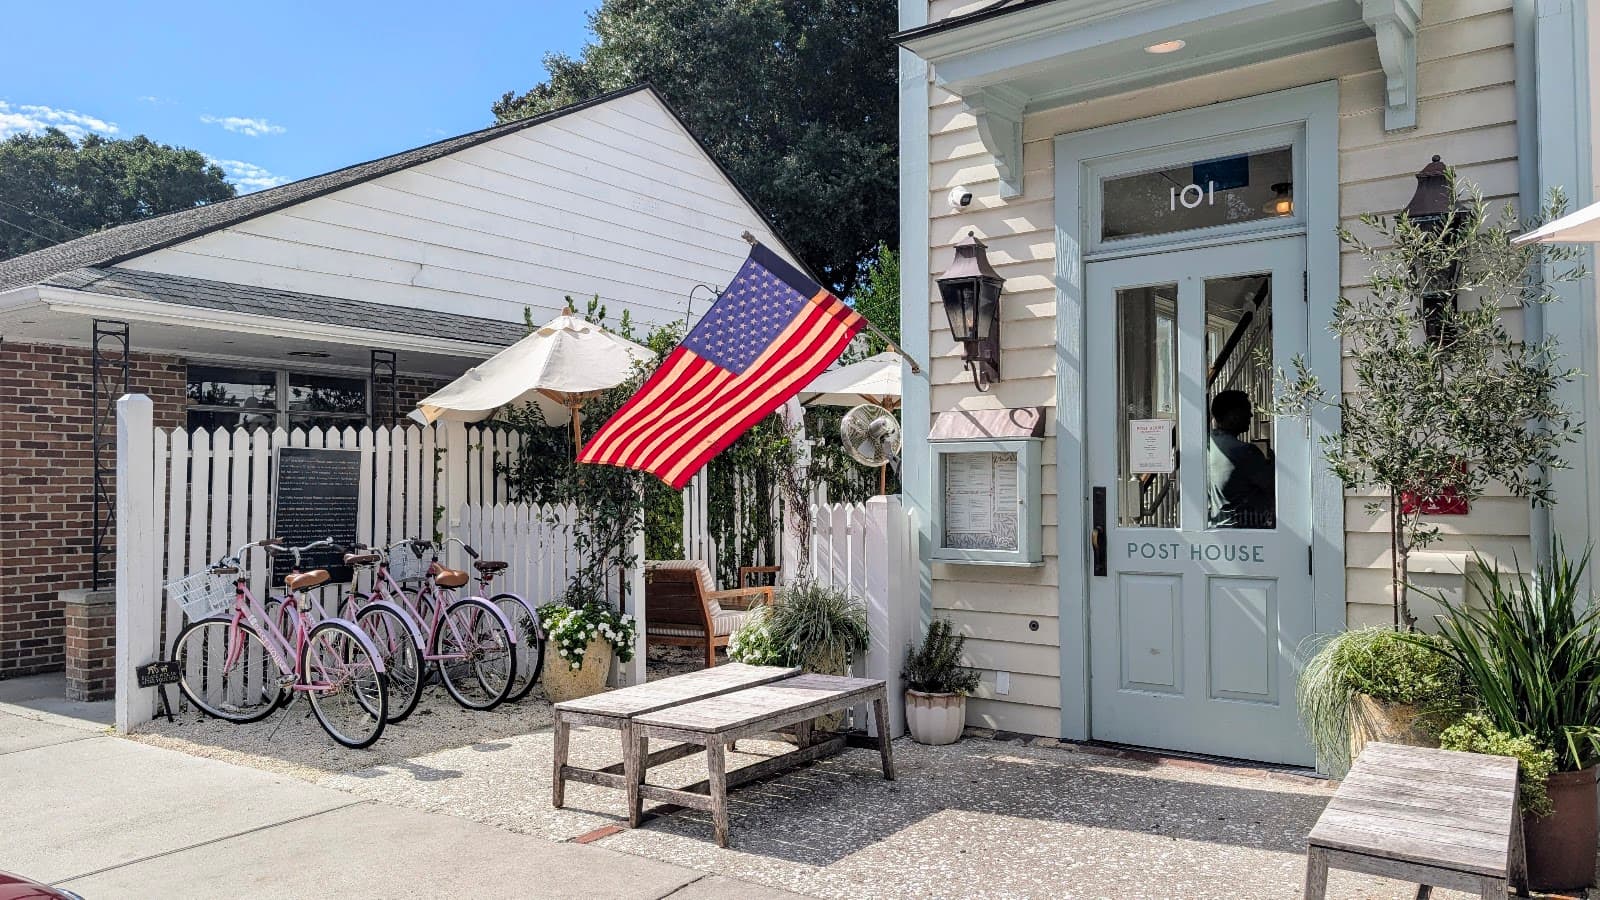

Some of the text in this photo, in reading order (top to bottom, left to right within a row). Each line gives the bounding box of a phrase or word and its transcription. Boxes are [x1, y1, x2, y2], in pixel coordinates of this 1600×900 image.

[1170, 180, 1214, 211] 101
[1127, 542, 1264, 562] POST HOUSE
